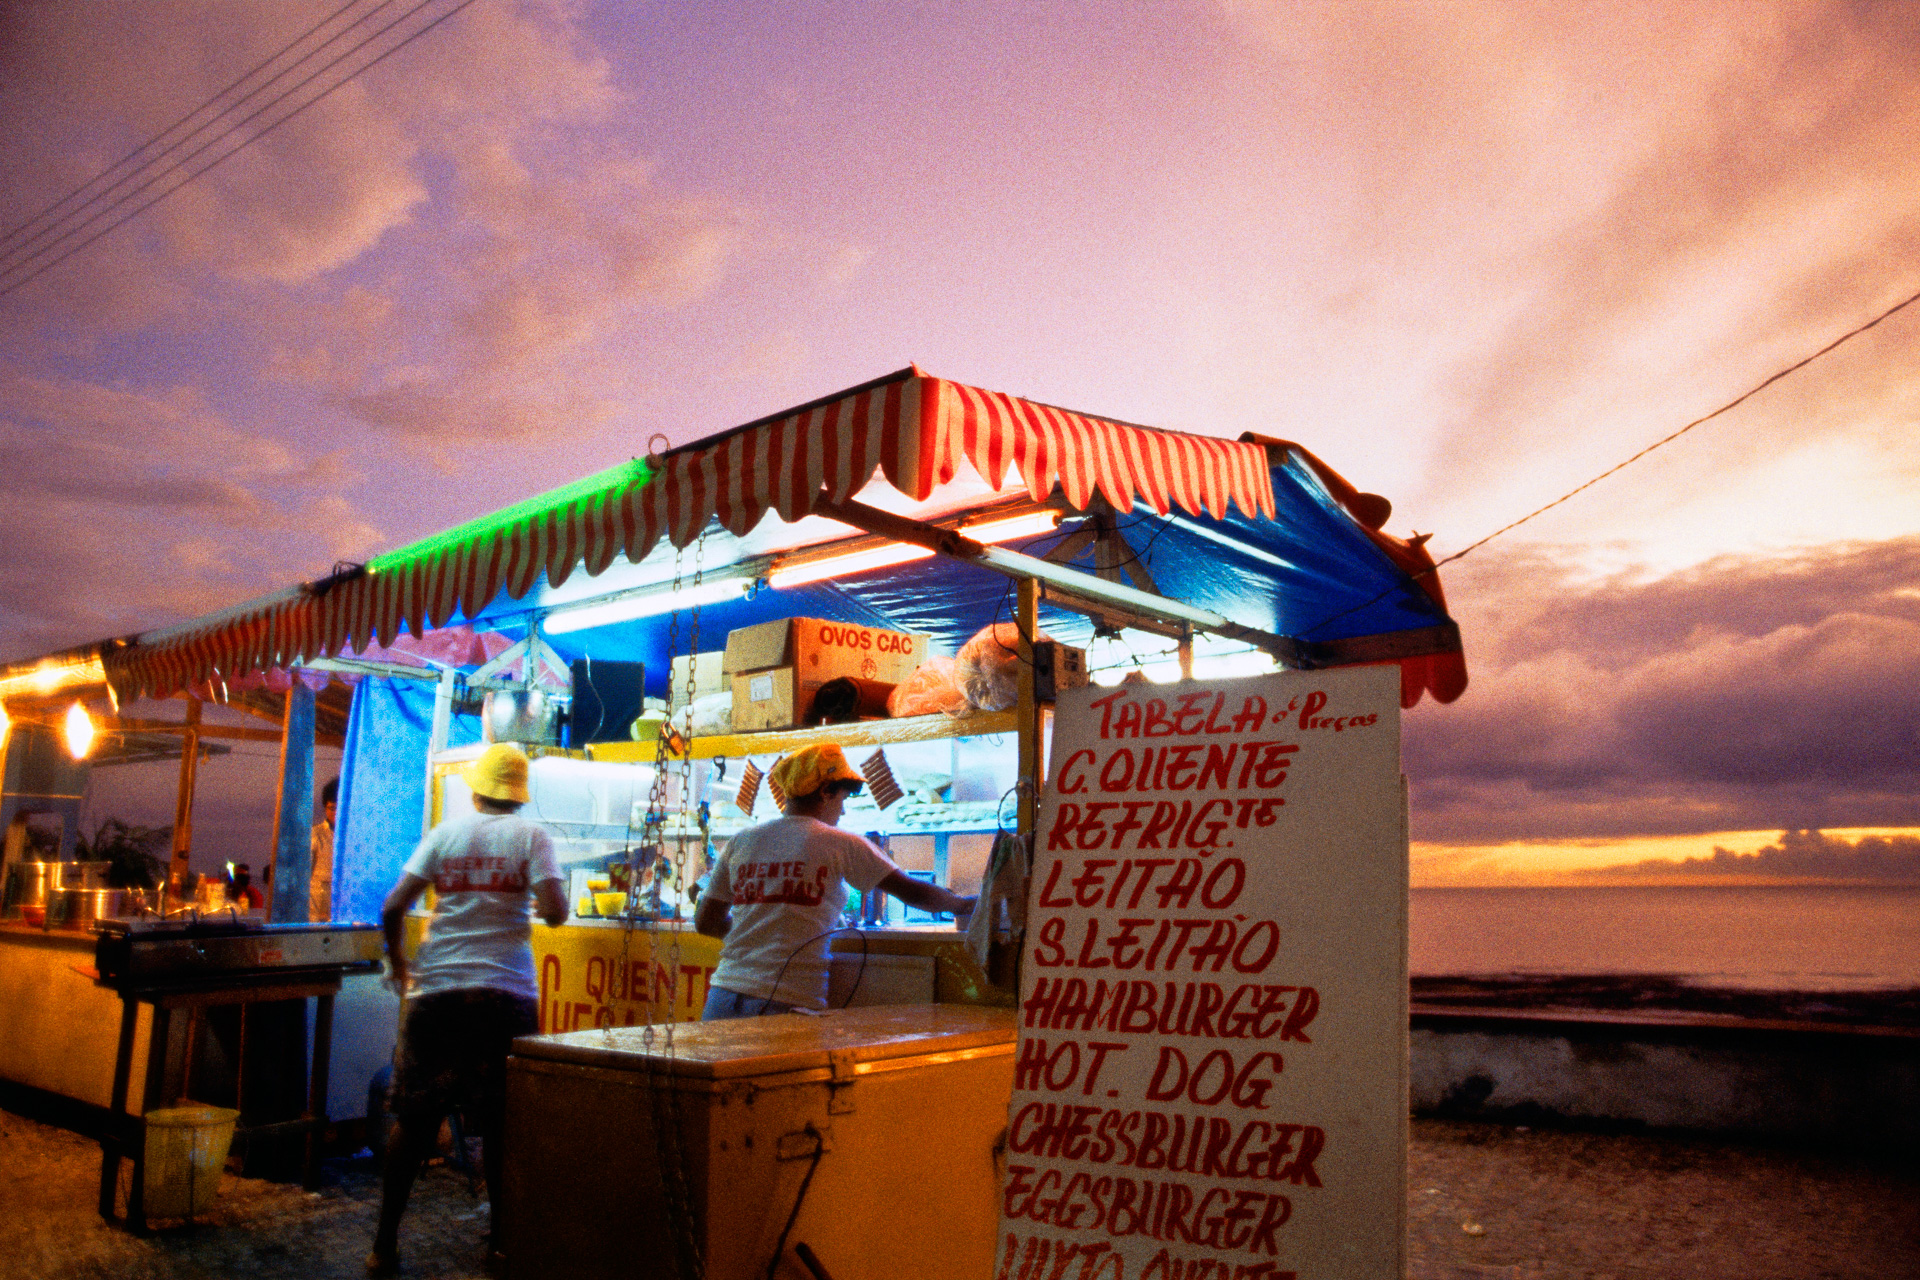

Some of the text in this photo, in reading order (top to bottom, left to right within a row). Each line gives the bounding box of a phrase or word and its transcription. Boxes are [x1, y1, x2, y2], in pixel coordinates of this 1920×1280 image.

[819, 625, 913, 655] OVOS CAC
[1090, 689, 1269, 739] TABELA
[738, 861, 805, 883] QUENTE
[1039, 848, 1247, 909] LEITÃO
[1024, 977, 1320, 1043] HAMBURGER
[1145, 1046, 1285, 1110] DOG
[1009, 1101, 1325, 1188] CHESSBURGER
[1004, 1165, 1292, 1256] EGGSBURGER
